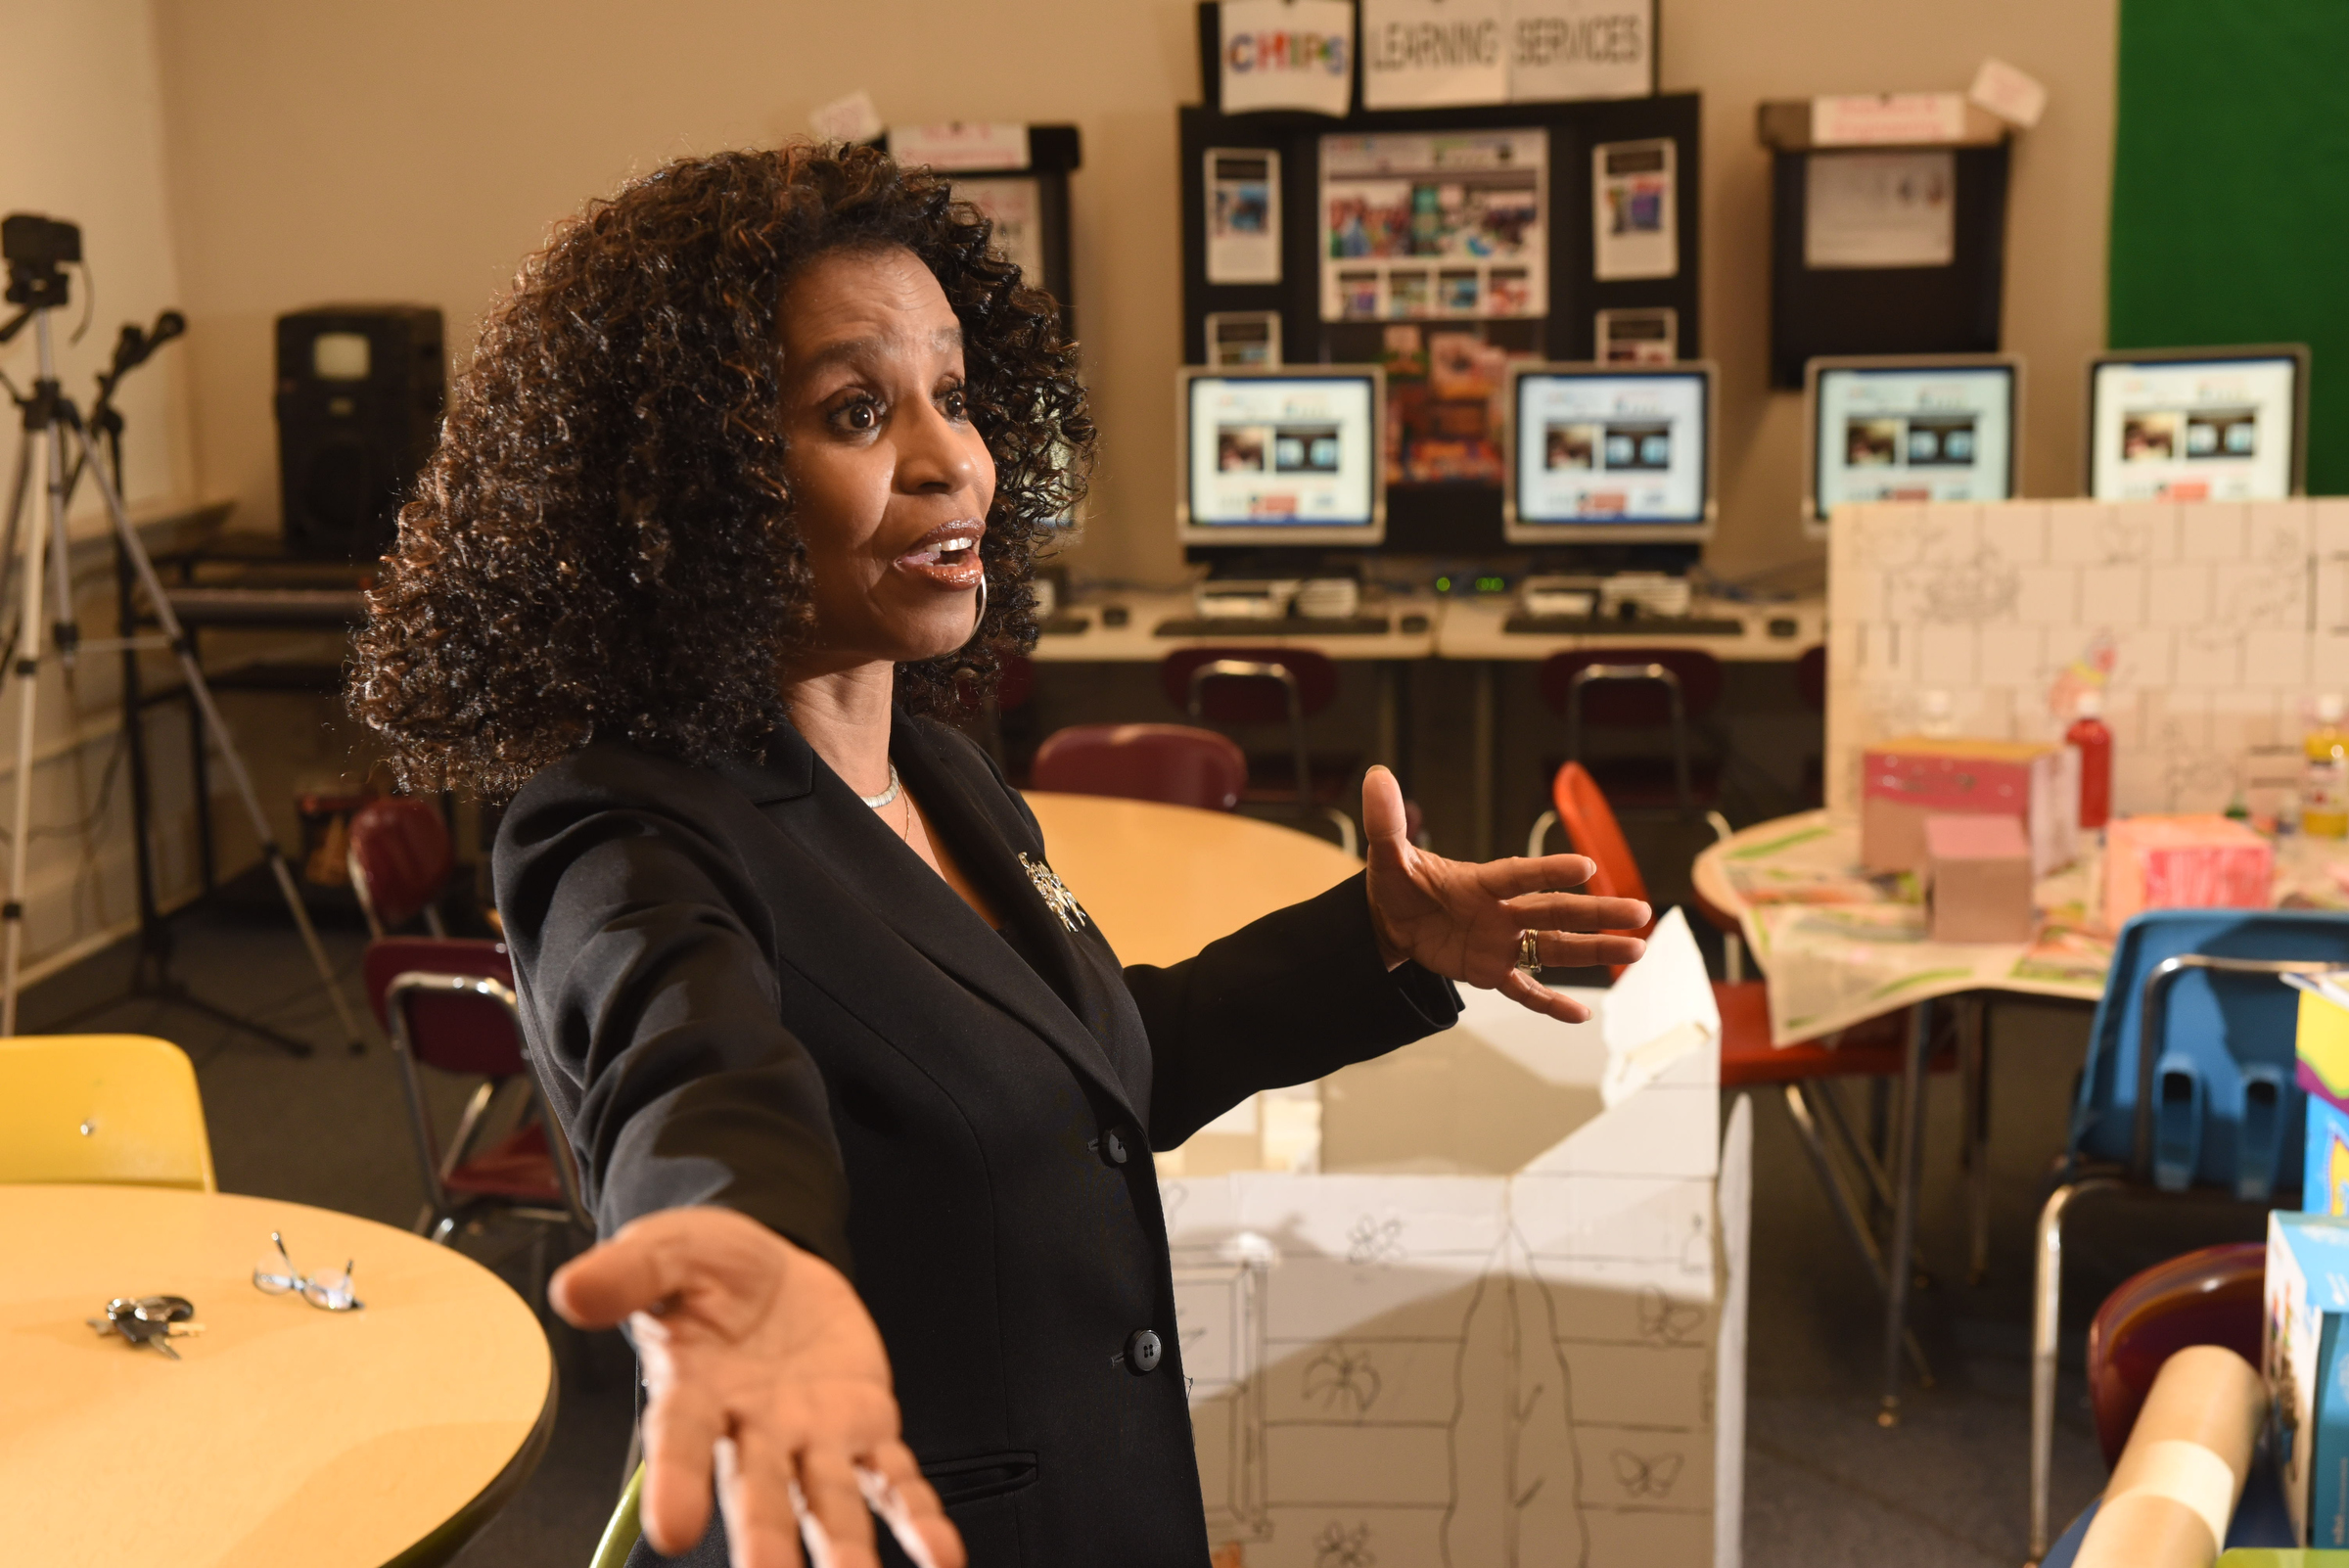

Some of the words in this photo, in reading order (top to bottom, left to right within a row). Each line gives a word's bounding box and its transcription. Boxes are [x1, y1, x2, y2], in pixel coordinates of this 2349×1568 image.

[1229, 31, 1346, 75] CHIPS
[1371, 19, 1498, 70] LEARNING
[1517, 14, 1642, 67] SERVICES
